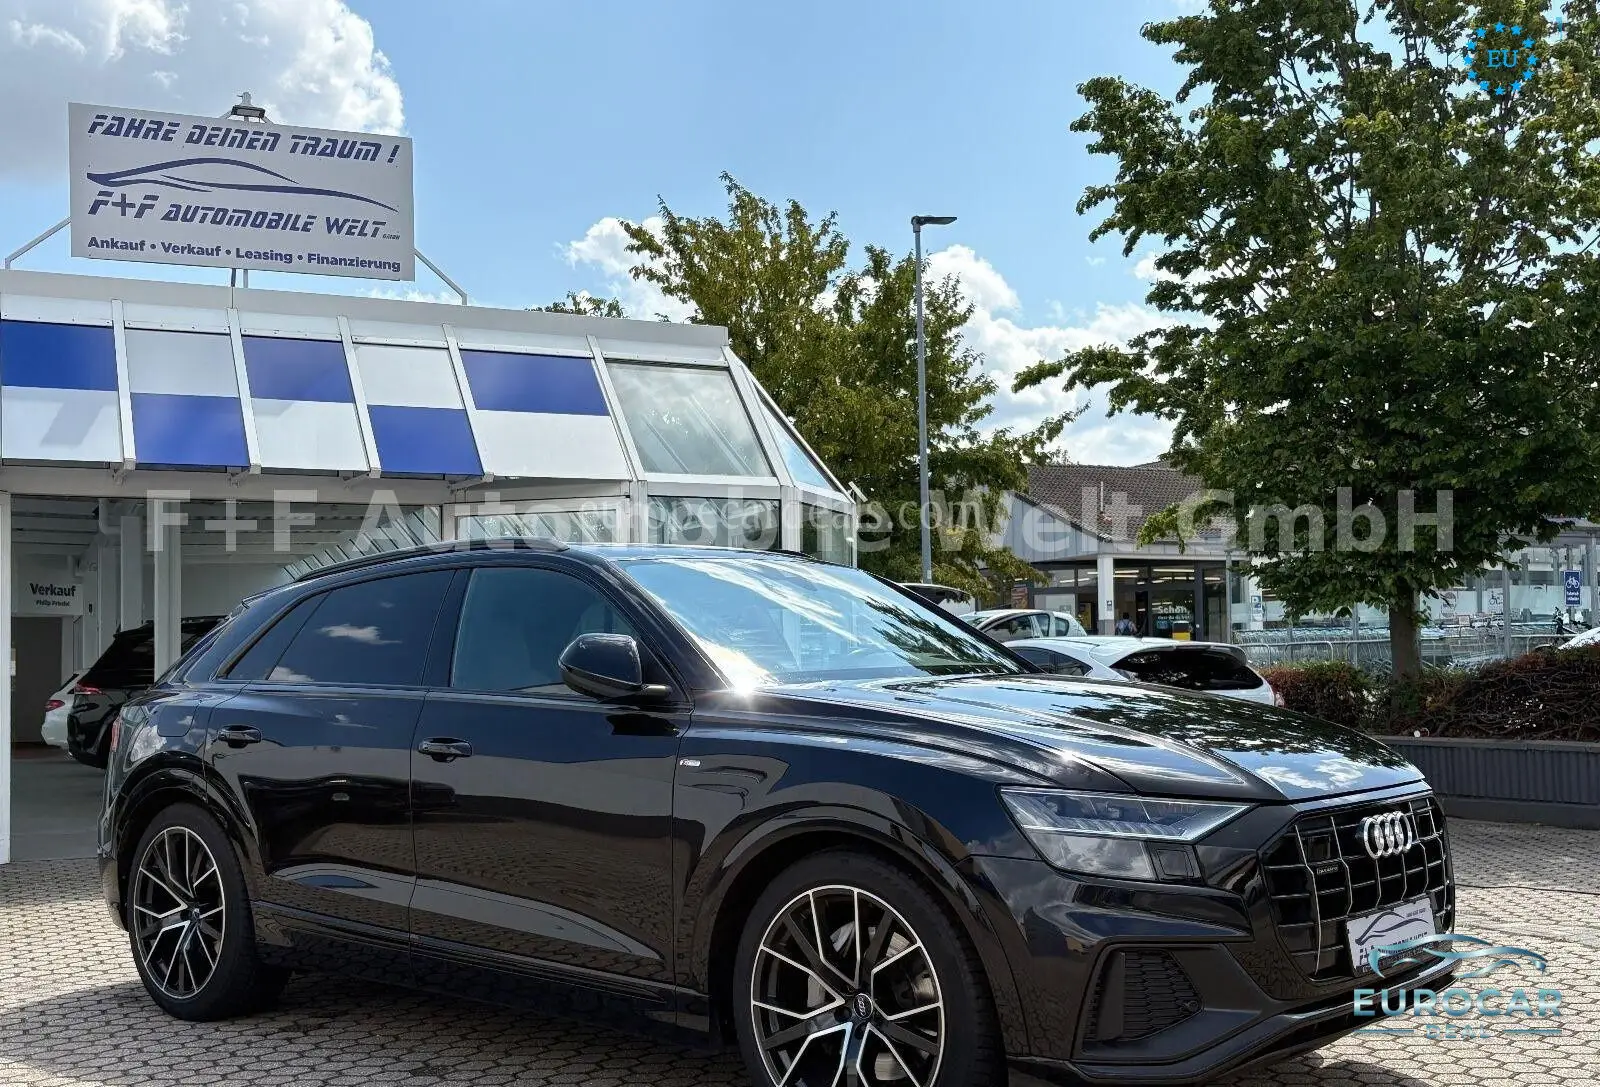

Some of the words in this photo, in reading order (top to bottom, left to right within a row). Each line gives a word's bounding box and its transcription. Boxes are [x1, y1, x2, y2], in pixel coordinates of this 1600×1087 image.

[88, 114, 180, 143] FAHRE
[185, 124, 281, 152] DEINEN
[289, 134, 381, 162] TRAUM
[88, 191, 160, 219] F+F
[160, 203, 317, 233] AUTOMOBILE
[325, 217, 387, 239] WELT
[88, 236, 146, 252] Ankauf
[160, 242, 222, 257] Verkauf
[235, 248, 293, 264] Leasing
[307, 253, 401, 273] Finanzierung
[29, 582, 76, 597] Verkauf
